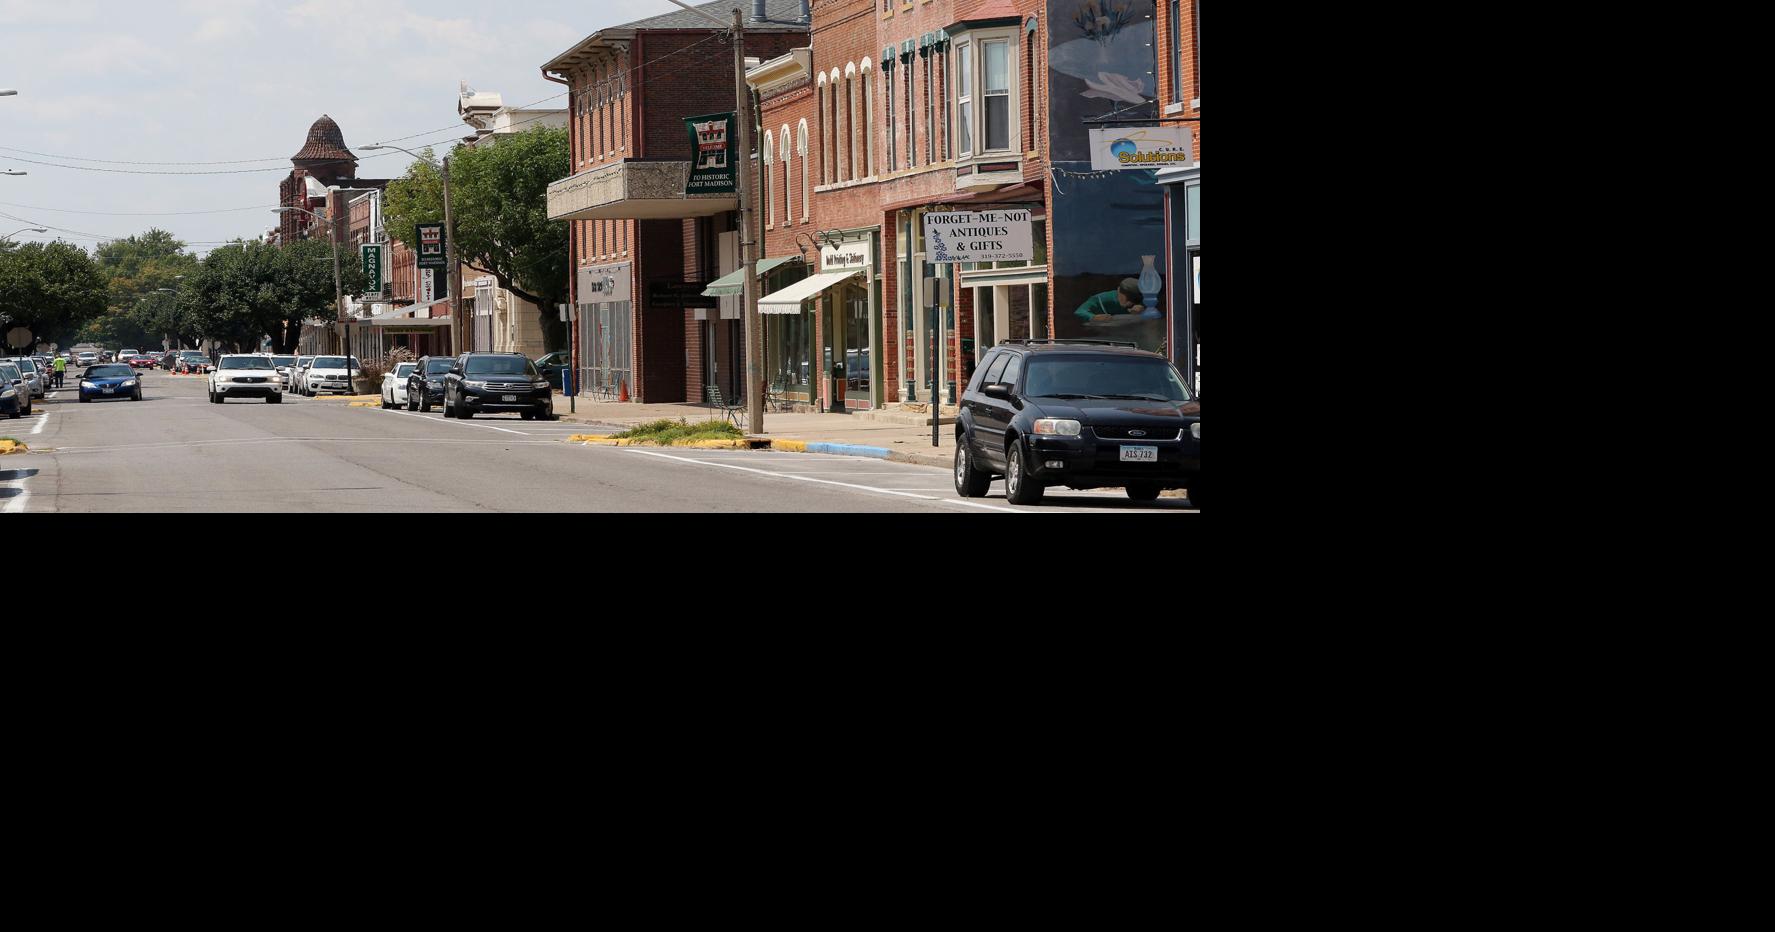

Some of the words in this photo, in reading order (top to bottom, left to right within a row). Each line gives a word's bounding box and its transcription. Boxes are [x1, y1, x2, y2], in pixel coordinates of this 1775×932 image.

[1119, 151, 1185, 163] Solutions
[927, 212, 1028, 225] FORGET-ME-NOT
[949, 226, 1008, 238] ANTIQUES
[956, 242, 966, 251] &
[970, 241, 1003, 251] GIFTS
[367, 247, 376, 291] MAGNAVOX
[1140, 450, 1153, 458] 732
